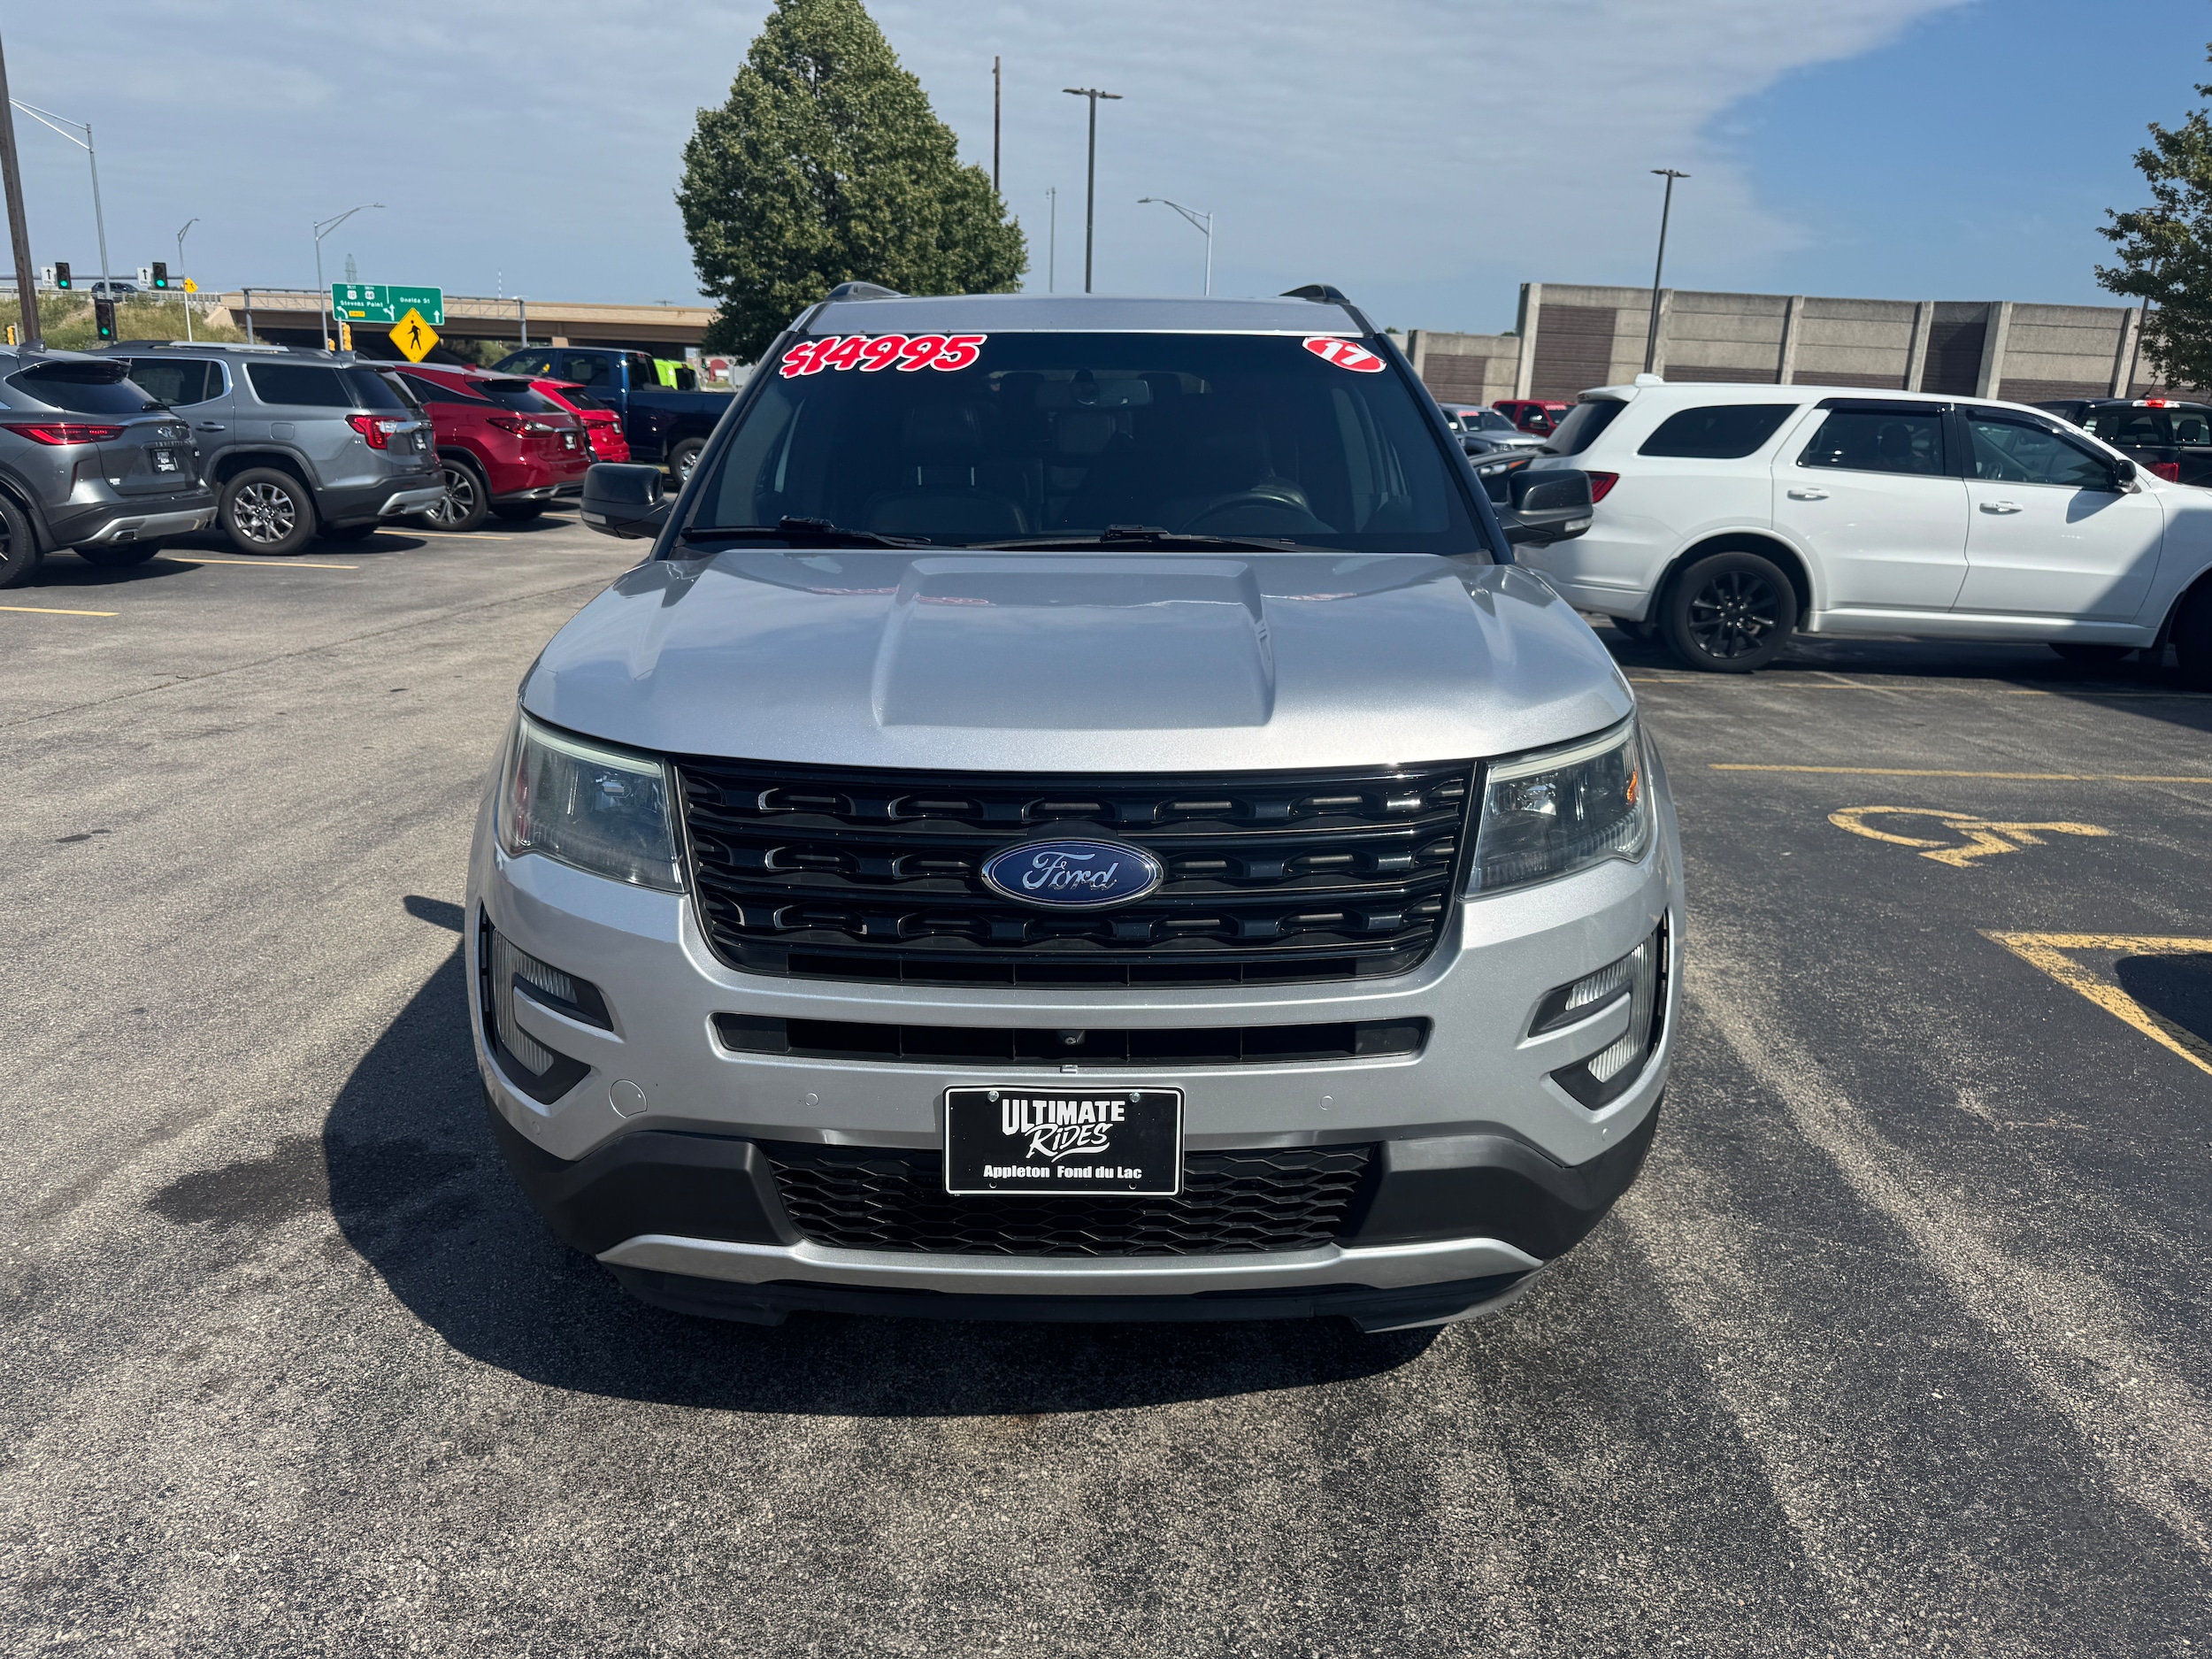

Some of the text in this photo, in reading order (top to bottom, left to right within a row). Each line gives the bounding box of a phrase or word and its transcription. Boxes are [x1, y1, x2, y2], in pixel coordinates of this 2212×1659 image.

[779, 334, 987, 379] $14995
[1320, 342, 1372, 366] 17
[1022, 851, 1119, 890] Ford
[1002, 1099, 1125, 1136] ULTIMATE
[984, 1165, 1142, 1179] Appleton Fond du Lac
